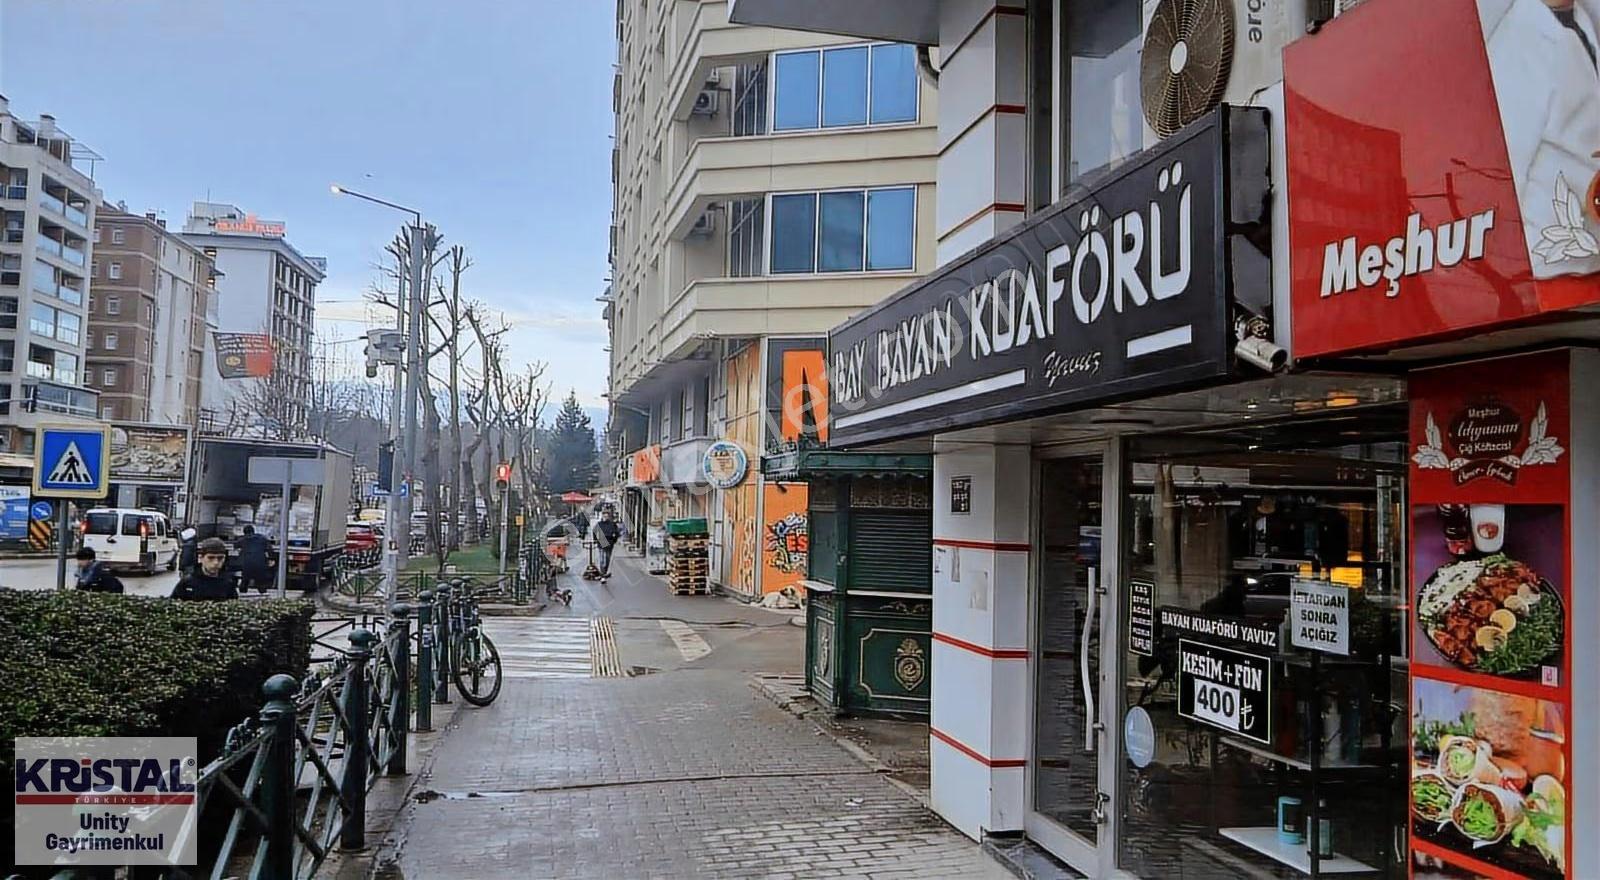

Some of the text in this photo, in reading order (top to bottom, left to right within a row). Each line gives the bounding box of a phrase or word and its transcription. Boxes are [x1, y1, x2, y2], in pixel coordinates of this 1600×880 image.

[1320, 209, 1496, 298] Meşhur
[834, 160, 1193, 404] BAY BAYAN KUAFÖRÜ
[1161, 611, 1190, 630] BAYAN
[1191, 615, 1238, 639] KUAFÖRÜ
[1240, 624, 1277, 647] YAVUZ
[1301, 608, 1338, 626] SONRA
[1197, 684, 1235, 718] 400
